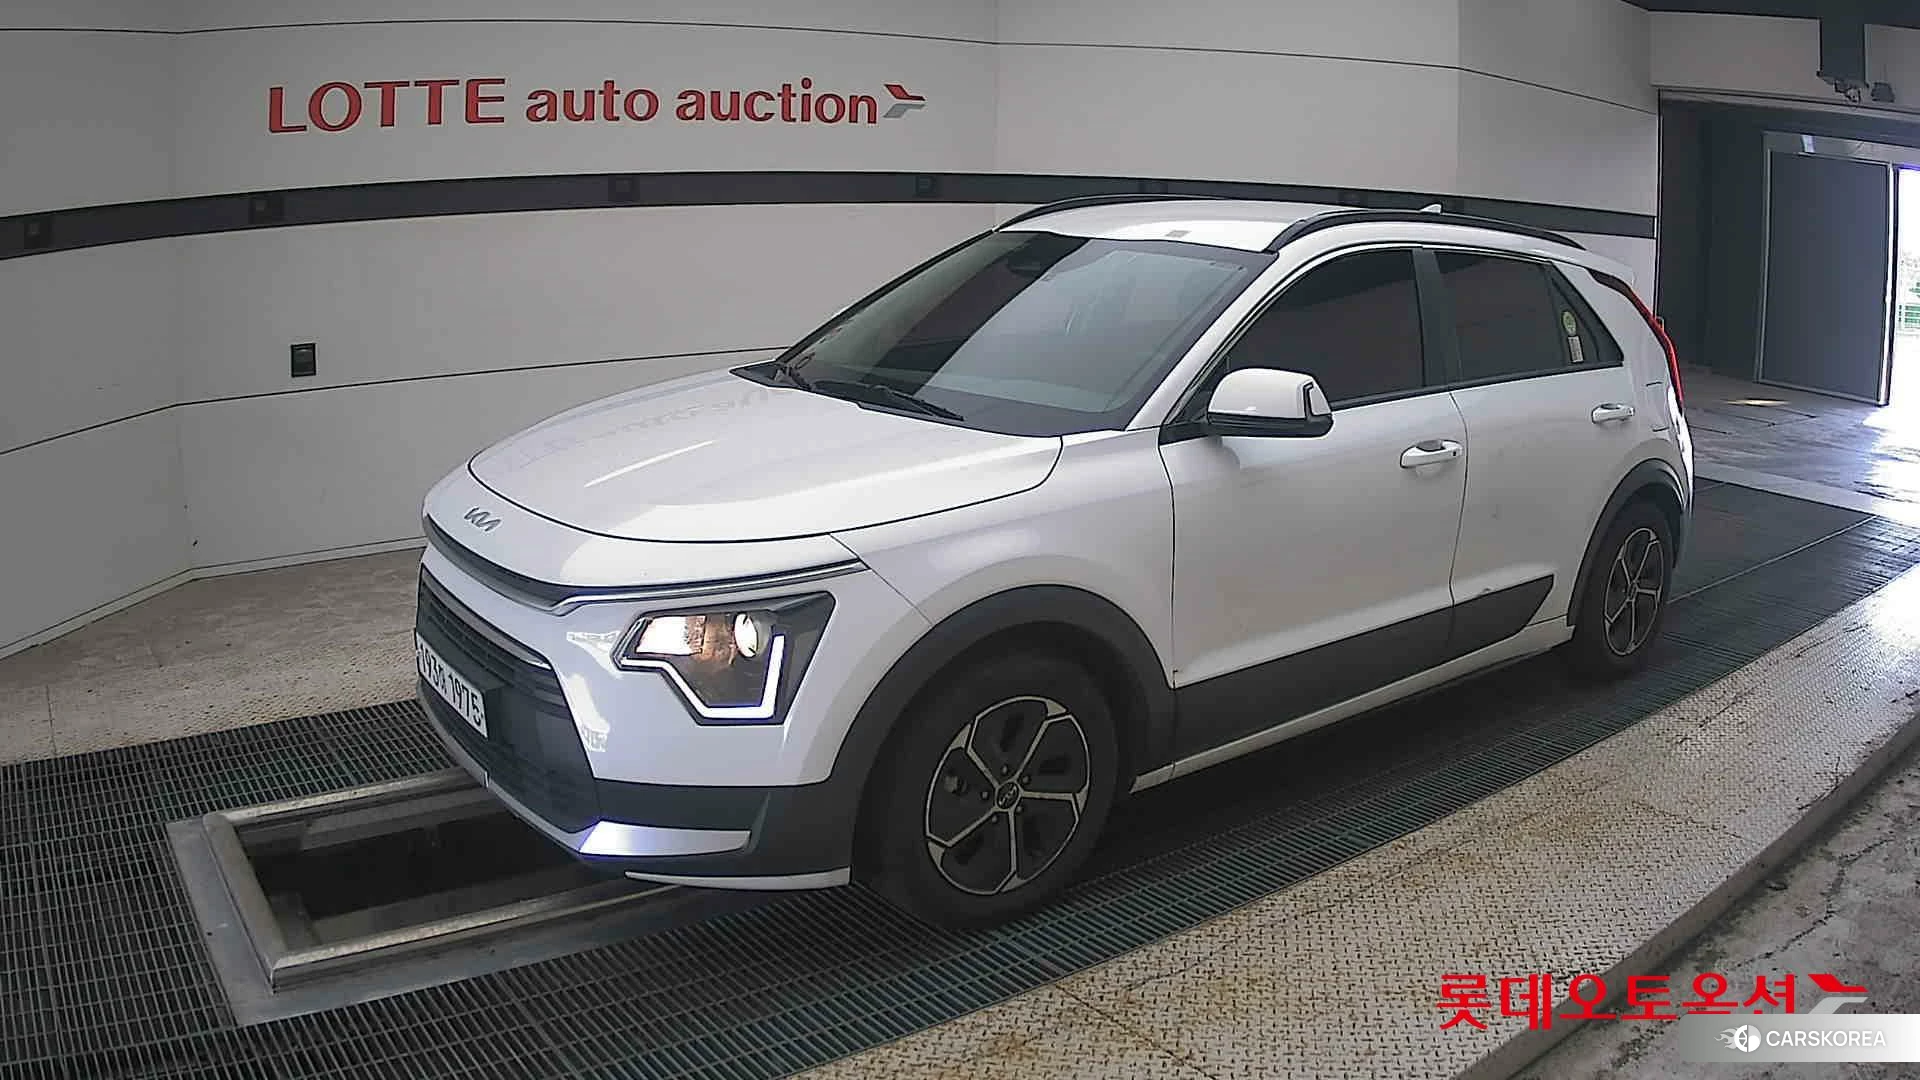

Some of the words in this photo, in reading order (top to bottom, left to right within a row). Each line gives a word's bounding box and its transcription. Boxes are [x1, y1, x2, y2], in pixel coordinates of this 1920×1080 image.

[268, 78, 505, 133] LOTTE
[526, 80, 659, 122] auto
[676, 78, 878, 124] auction
[448, 673, 482, 726] 1975
